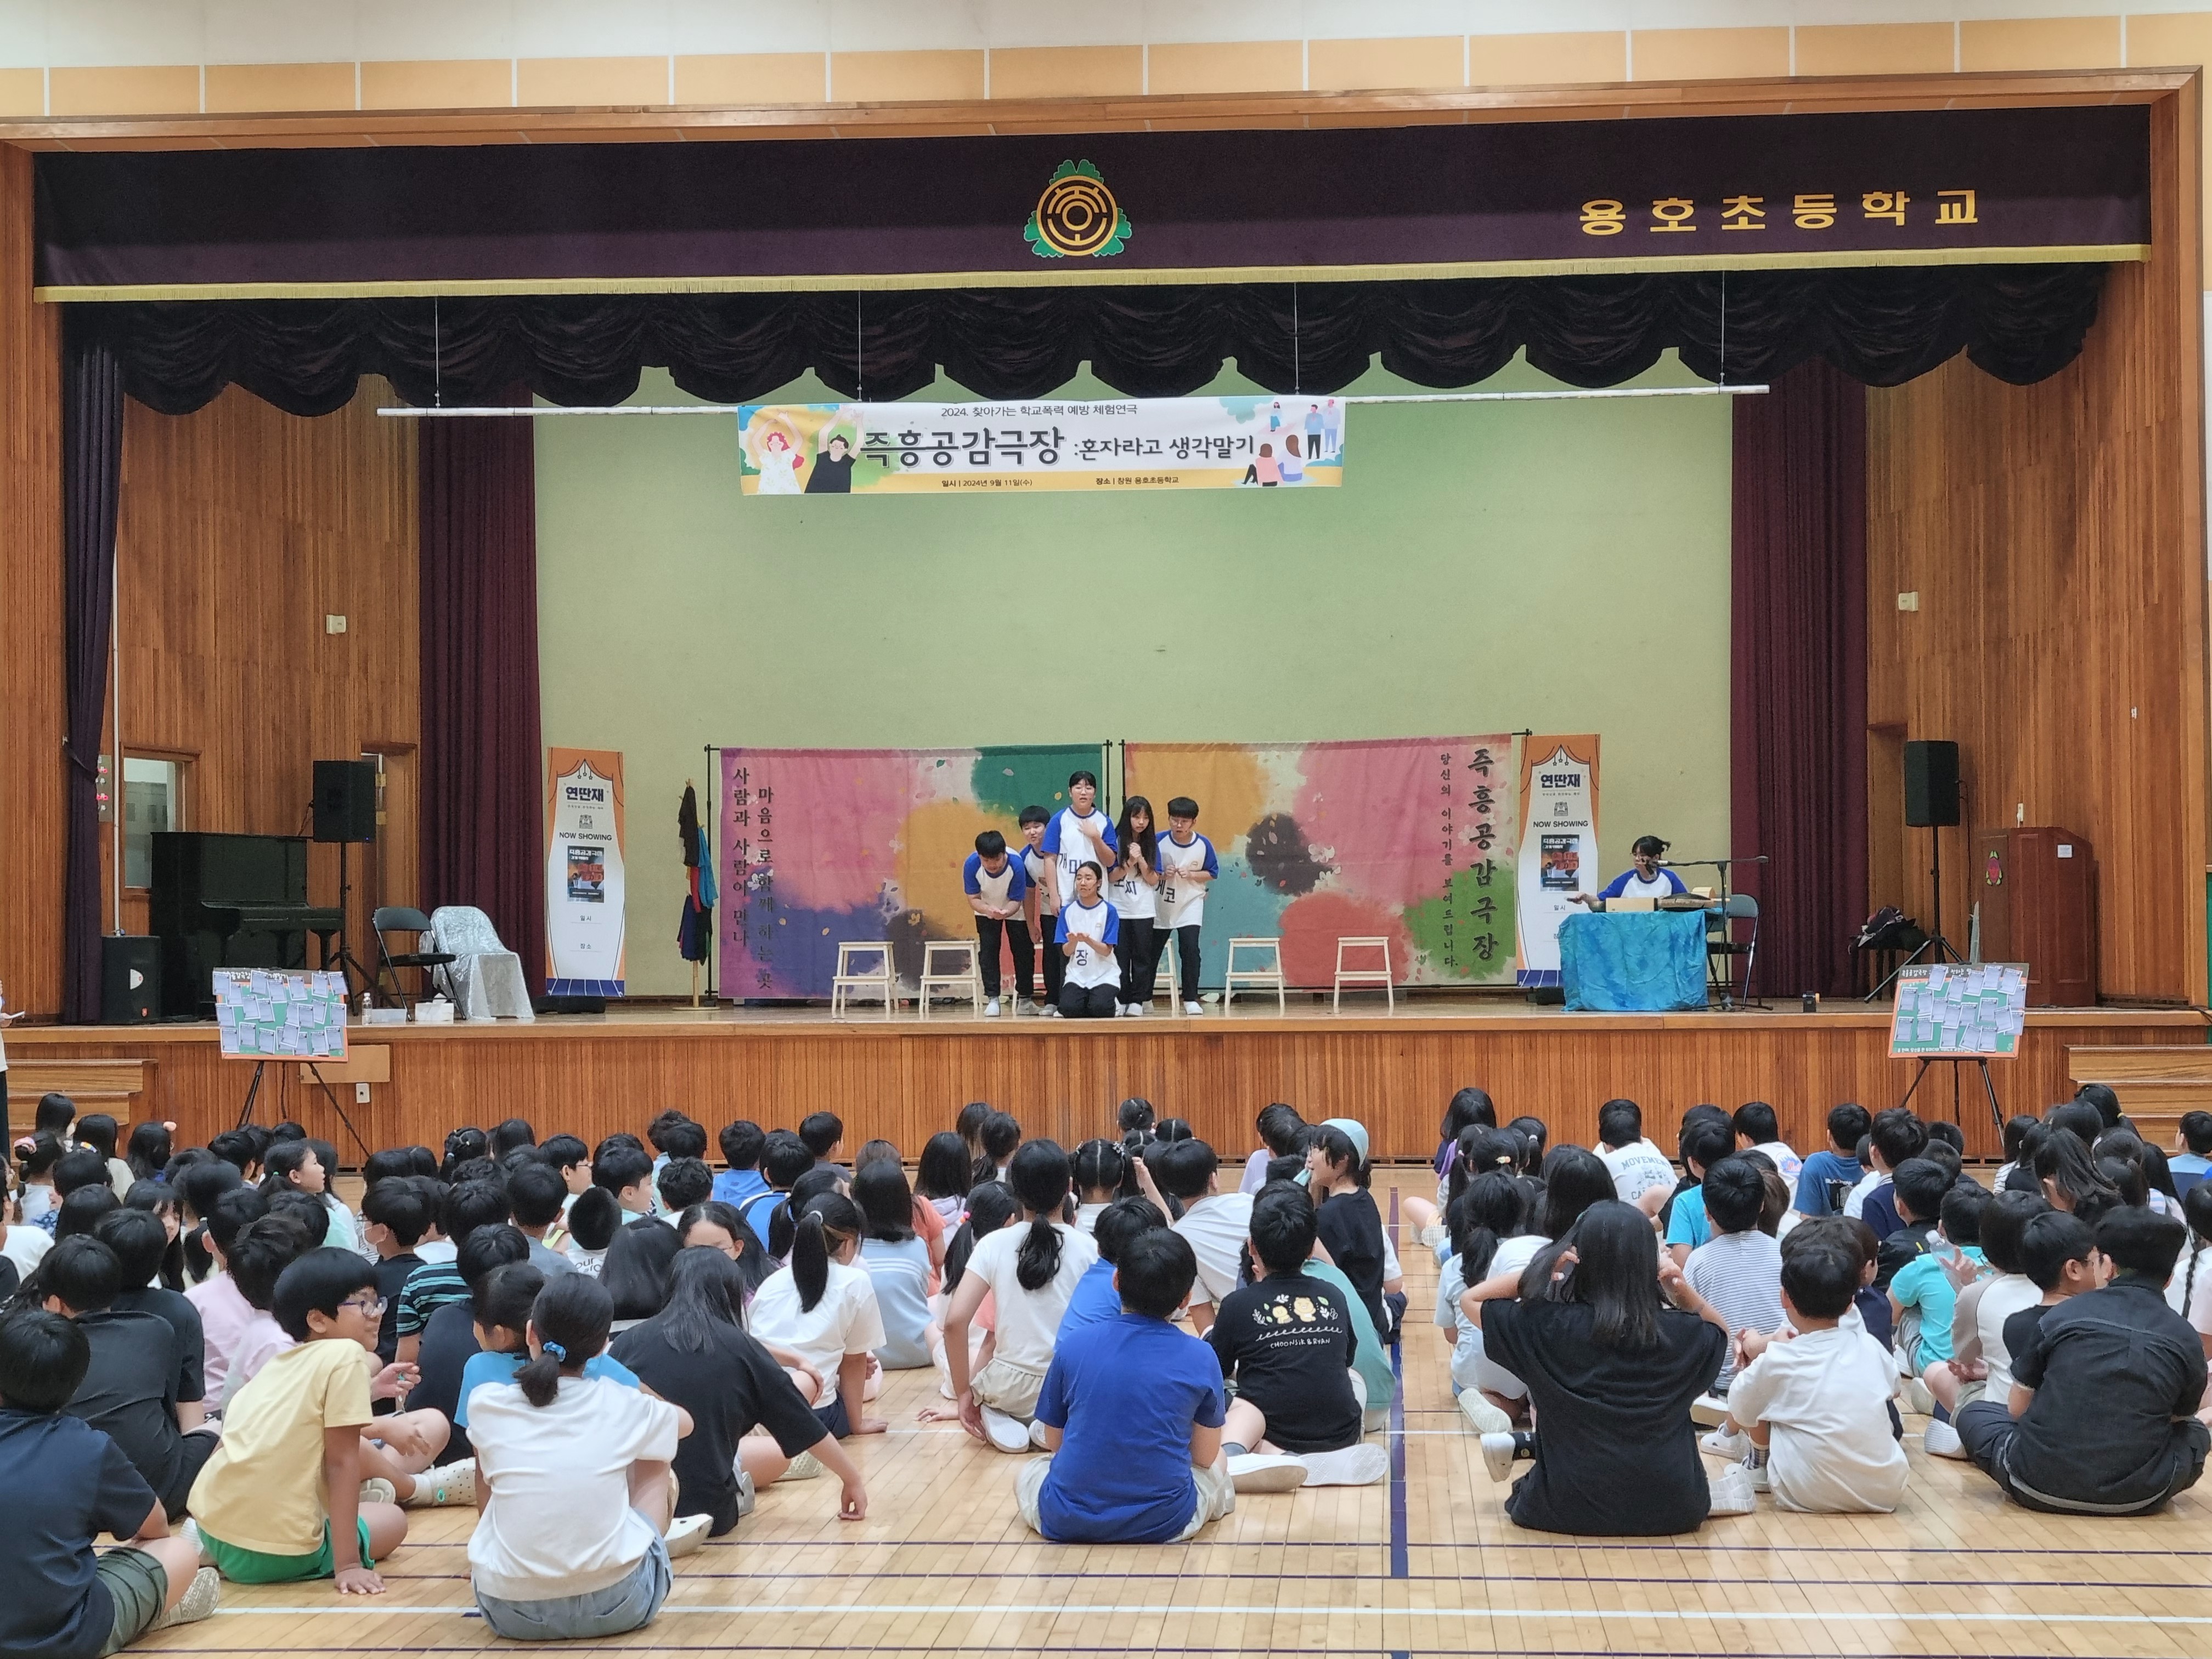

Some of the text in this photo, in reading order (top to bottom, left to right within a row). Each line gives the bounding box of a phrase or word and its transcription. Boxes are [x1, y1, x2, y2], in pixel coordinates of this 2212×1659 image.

[1579, 189, 1978, 236] 용호초등학교
[941, 404, 1138, 417] 2024. 찾아가는 학교폭력 예방 체험연극
[860, 426, 1065, 468] 즉흥공감극장
[1169, 435, 1254, 459] 생각말기
[1135, 476, 1180, 484] 용호초등학교
[566, 787, 604, 802] 연딴재
[1440, 753, 1452, 797] 당신의
[1541, 774, 1580, 788] 연딴재
[578, 833, 612, 841] SHOWING
[757, 786, 774, 865] 마음으로
[1441, 808, 1453, 866] 이야기를
[733, 767, 750, 948] 사람과 사람이 만나
[1468, 748, 1499, 962] 즉흥공감극장
[1076, 949, 1088, 966] 장
